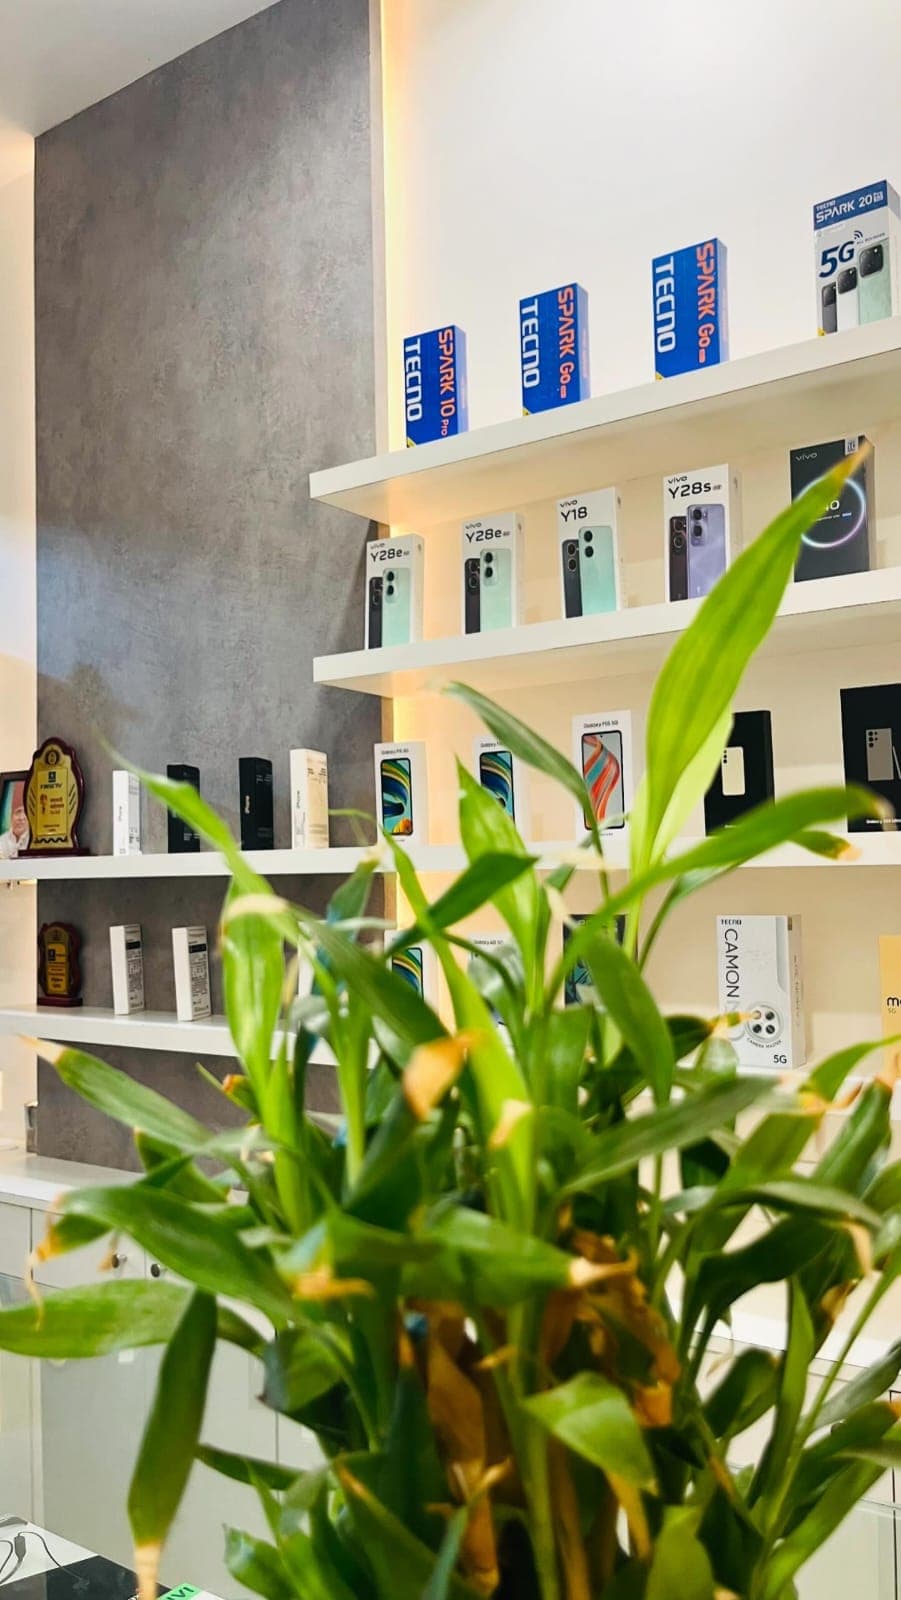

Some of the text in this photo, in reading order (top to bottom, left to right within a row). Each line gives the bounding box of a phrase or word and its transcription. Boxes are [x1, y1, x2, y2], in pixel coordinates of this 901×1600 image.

[816, 200, 855, 223] SPARK
[858, 194, 872, 208] 20
[818, 241, 855, 278] 5G
[655, 255, 676, 353] TECNO
[696, 242, 716, 348] SPARK Go
[558, 287, 575, 358] SPARK
[521, 298, 540, 388] TECNO
[405, 338, 422, 422] TECNO
[438, 328, 455, 436] SPARK 10 Pro
[560, 362, 575, 384] Go
[795, 452, 818, 461] vivo
[667, 475, 688, 484] vivo
[668, 481, 712, 500] Y28s
[560, 499, 578, 508] vivo
[560, 506, 588, 522] Y18
[466, 528, 502, 543] Y28e
[370, 548, 403, 562] Y28e
[724, 928, 740, 998] CAMON
[773, 1054, 788, 1064] 5G
